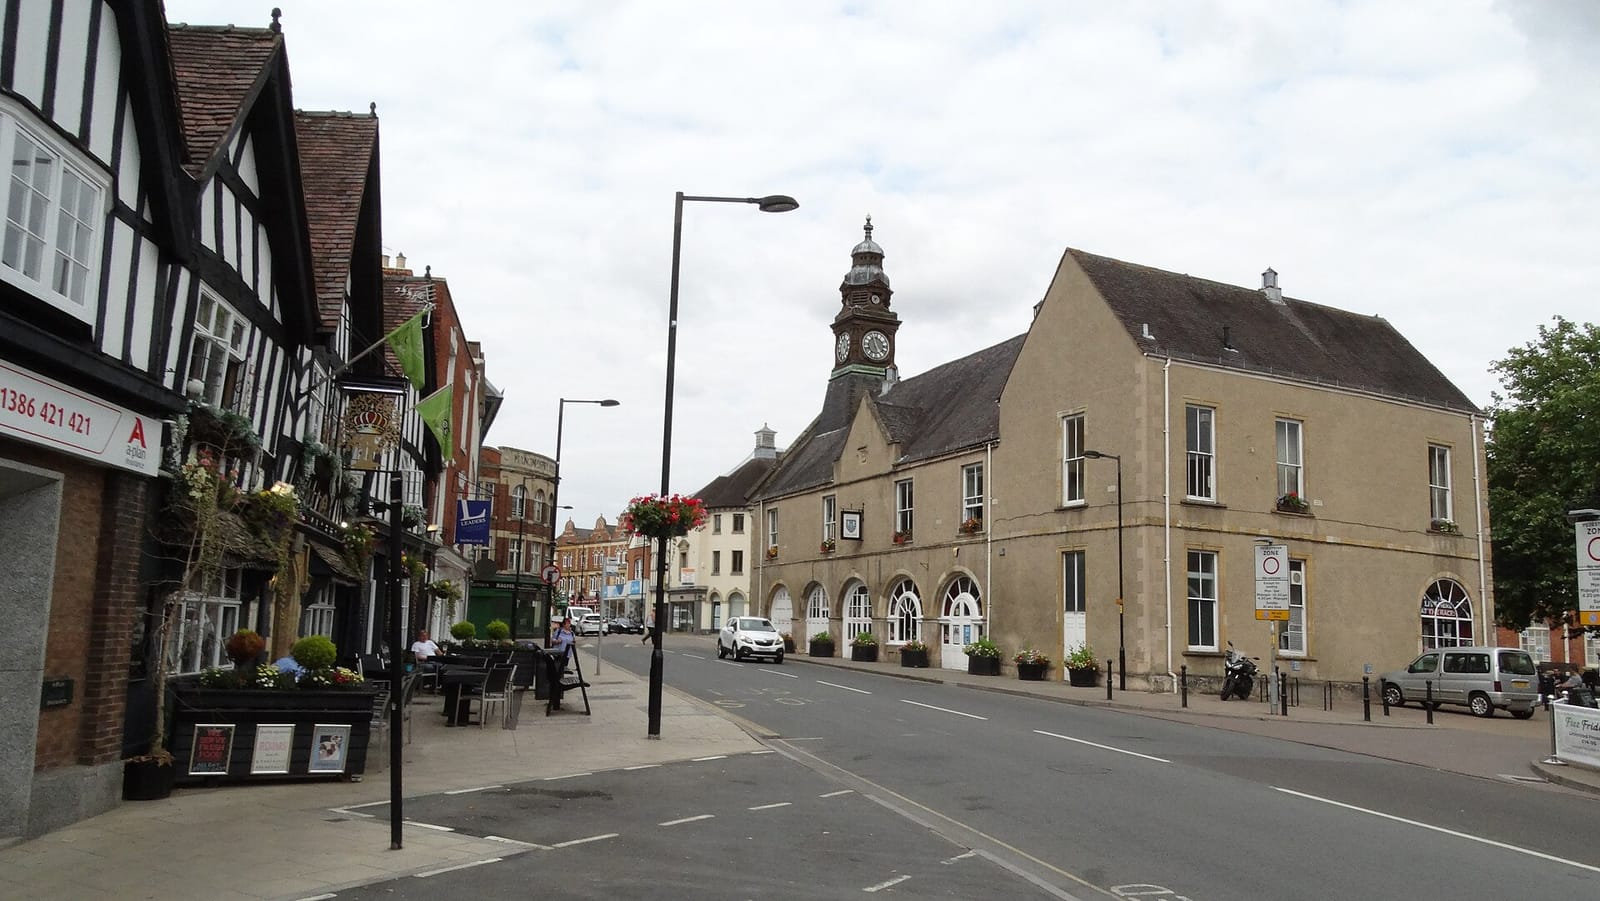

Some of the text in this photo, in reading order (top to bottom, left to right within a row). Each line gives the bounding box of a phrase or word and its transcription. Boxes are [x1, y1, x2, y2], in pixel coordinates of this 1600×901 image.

[40, 401, 64, 427] 421
[68, 412, 91, 436] 421
[460, 518, 487, 527] LEADERS
[1581, 719, 1600, 731] Frid
